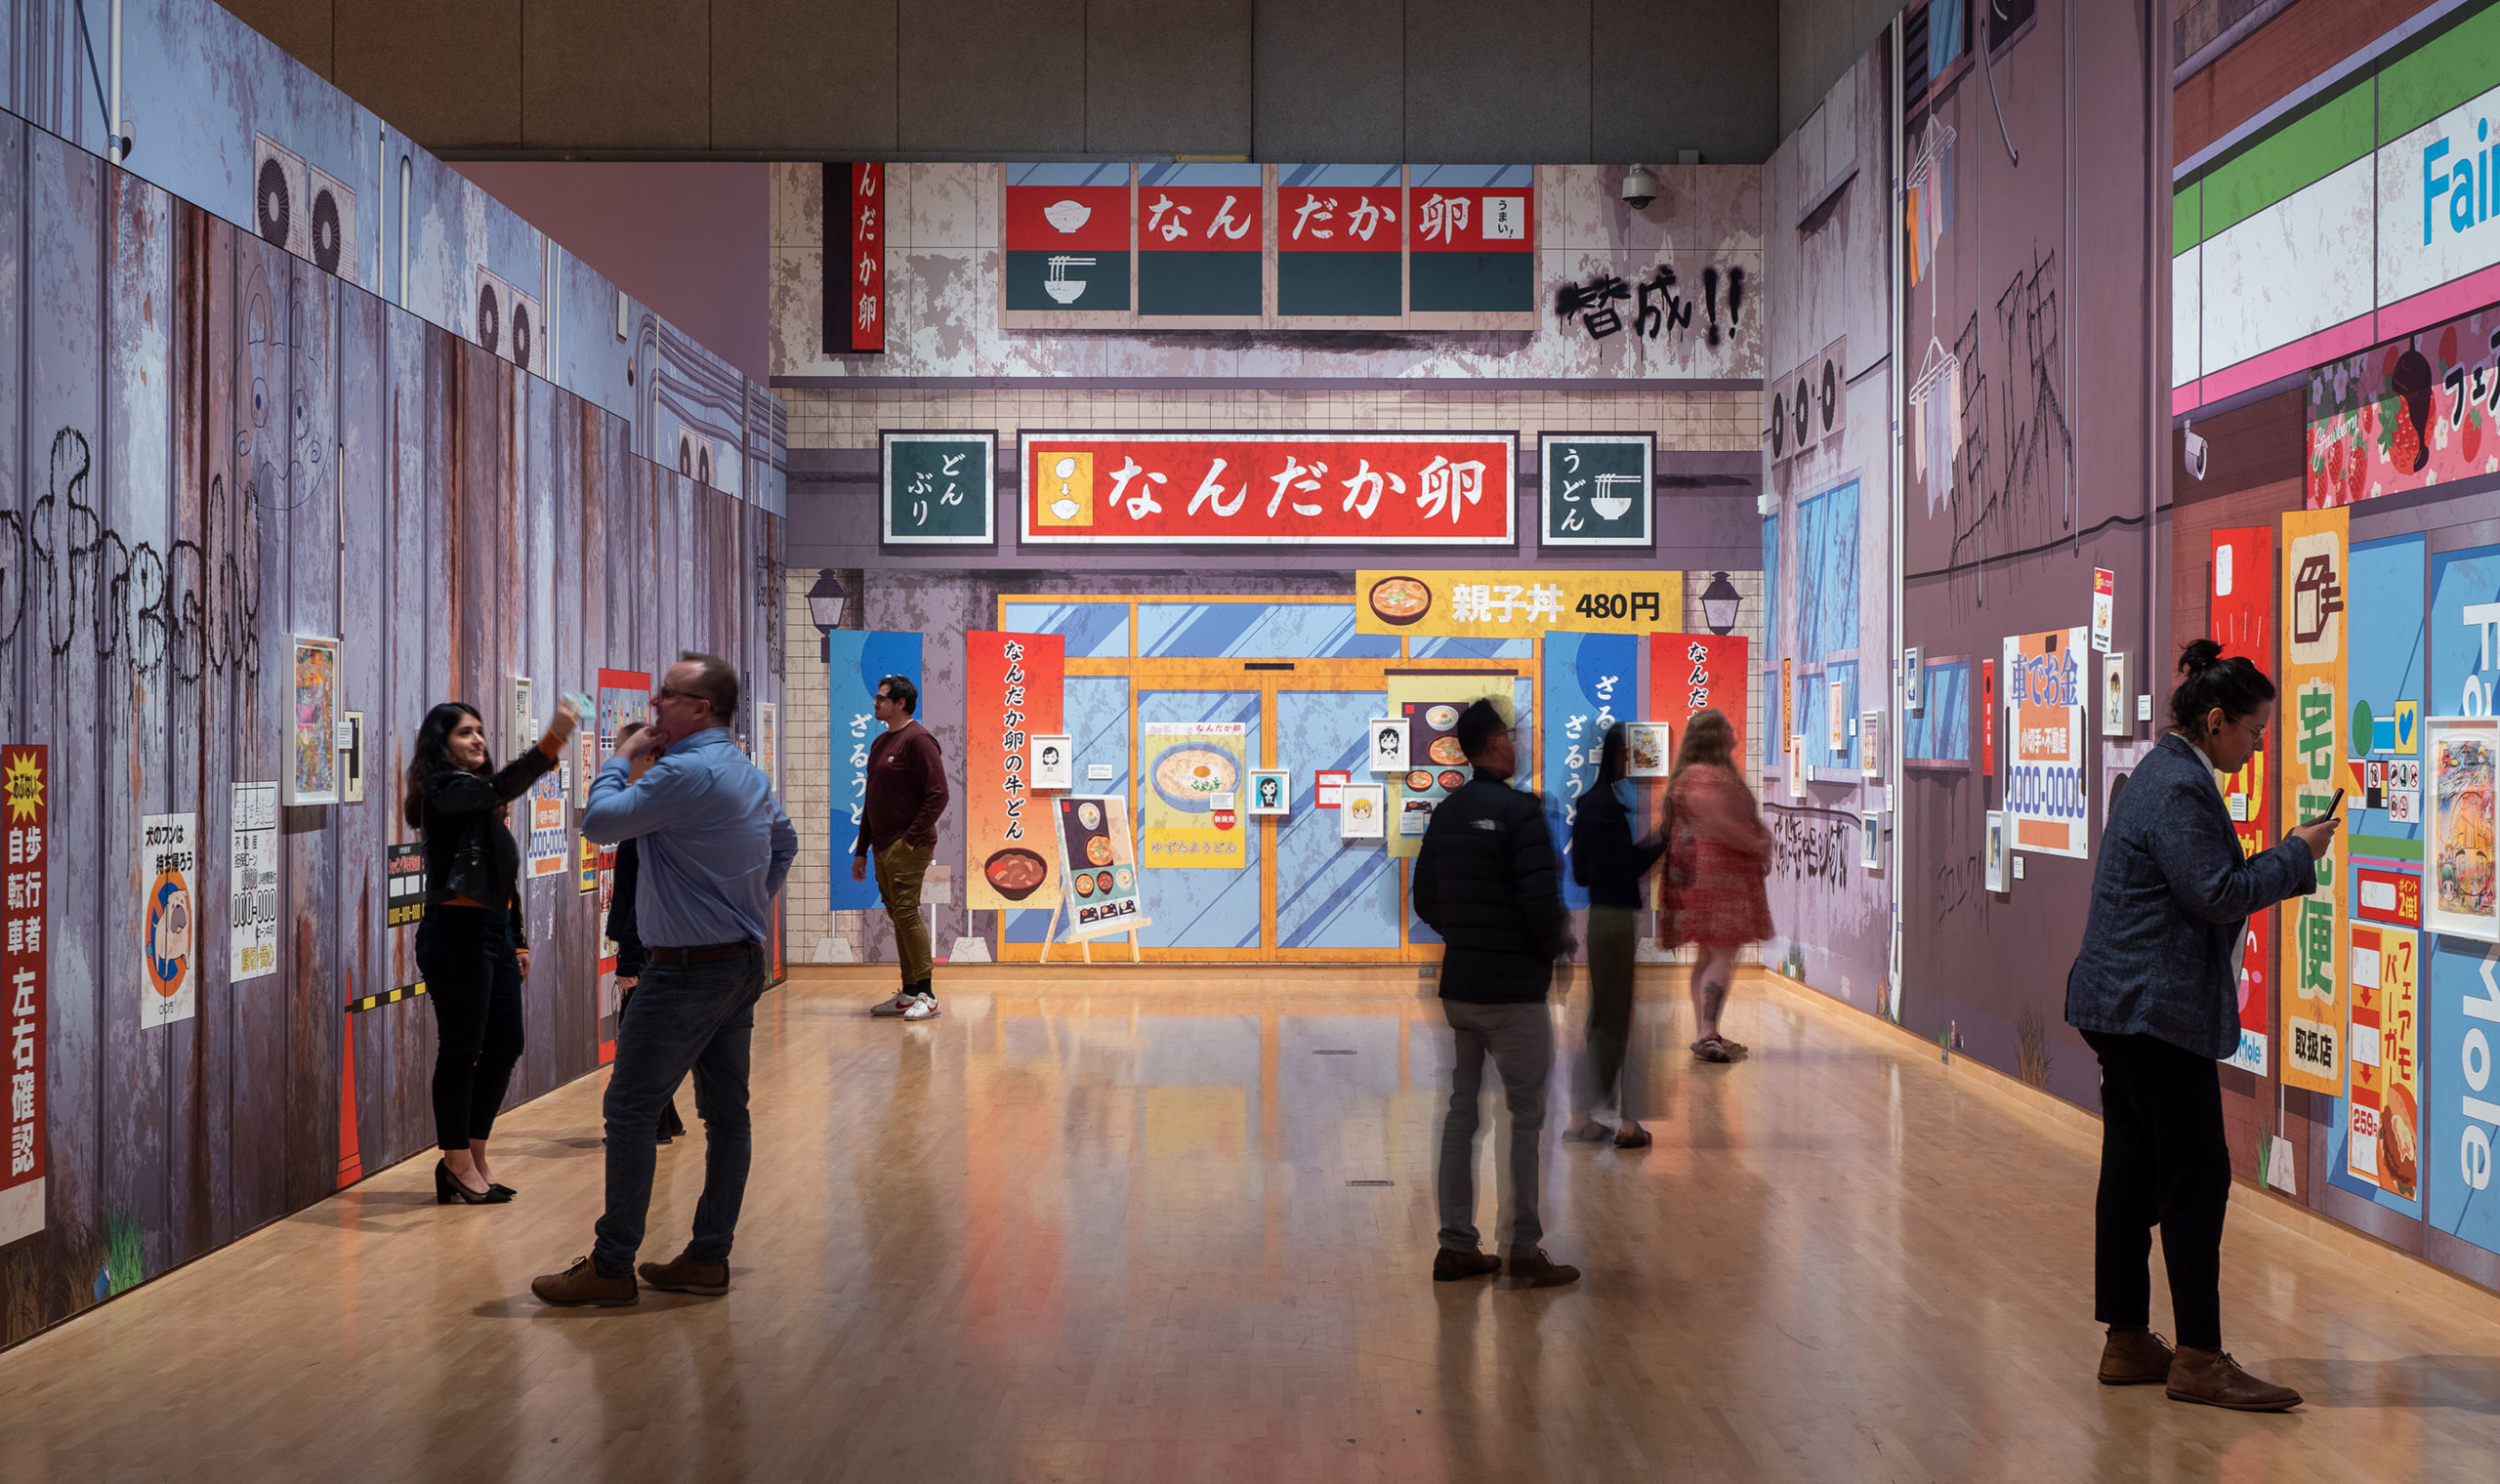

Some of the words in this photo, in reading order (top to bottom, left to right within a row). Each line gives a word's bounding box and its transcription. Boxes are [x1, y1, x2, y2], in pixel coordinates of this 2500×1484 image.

[1146, 192, 1472, 246] なんだか卵
[1498, 199, 1514, 237] うまい!
[859, 163, 877, 333] んだか卵
[2313, 414, 2359, 473] Strawberry
[908, 472, 933, 527] ぶり
[940, 453, 966, 506] どん
[1108, 455, 1485, 523] なんだか卵
[1561, 448, 1587, 532] うどん
[1452, 582, 1564, 623] 親子丼
[1575, 592, 1660, 622] 480円
[1688, 641, 1709, 721] なんだ
[2011, 647, 2078, 710] 車でお金
[1003, 639, 1024, 841] なんだか卵の牛どん
[146, 825, 185, 846] 犬のフンは
[1150, 841, 1237, 855] ゆずたまうどん
[2398, 941, 2411, 1081] フェアモ
[12, 966, 36, 1175] 左右確認
[2294, 1026, 2333, 1068] 取扱店
